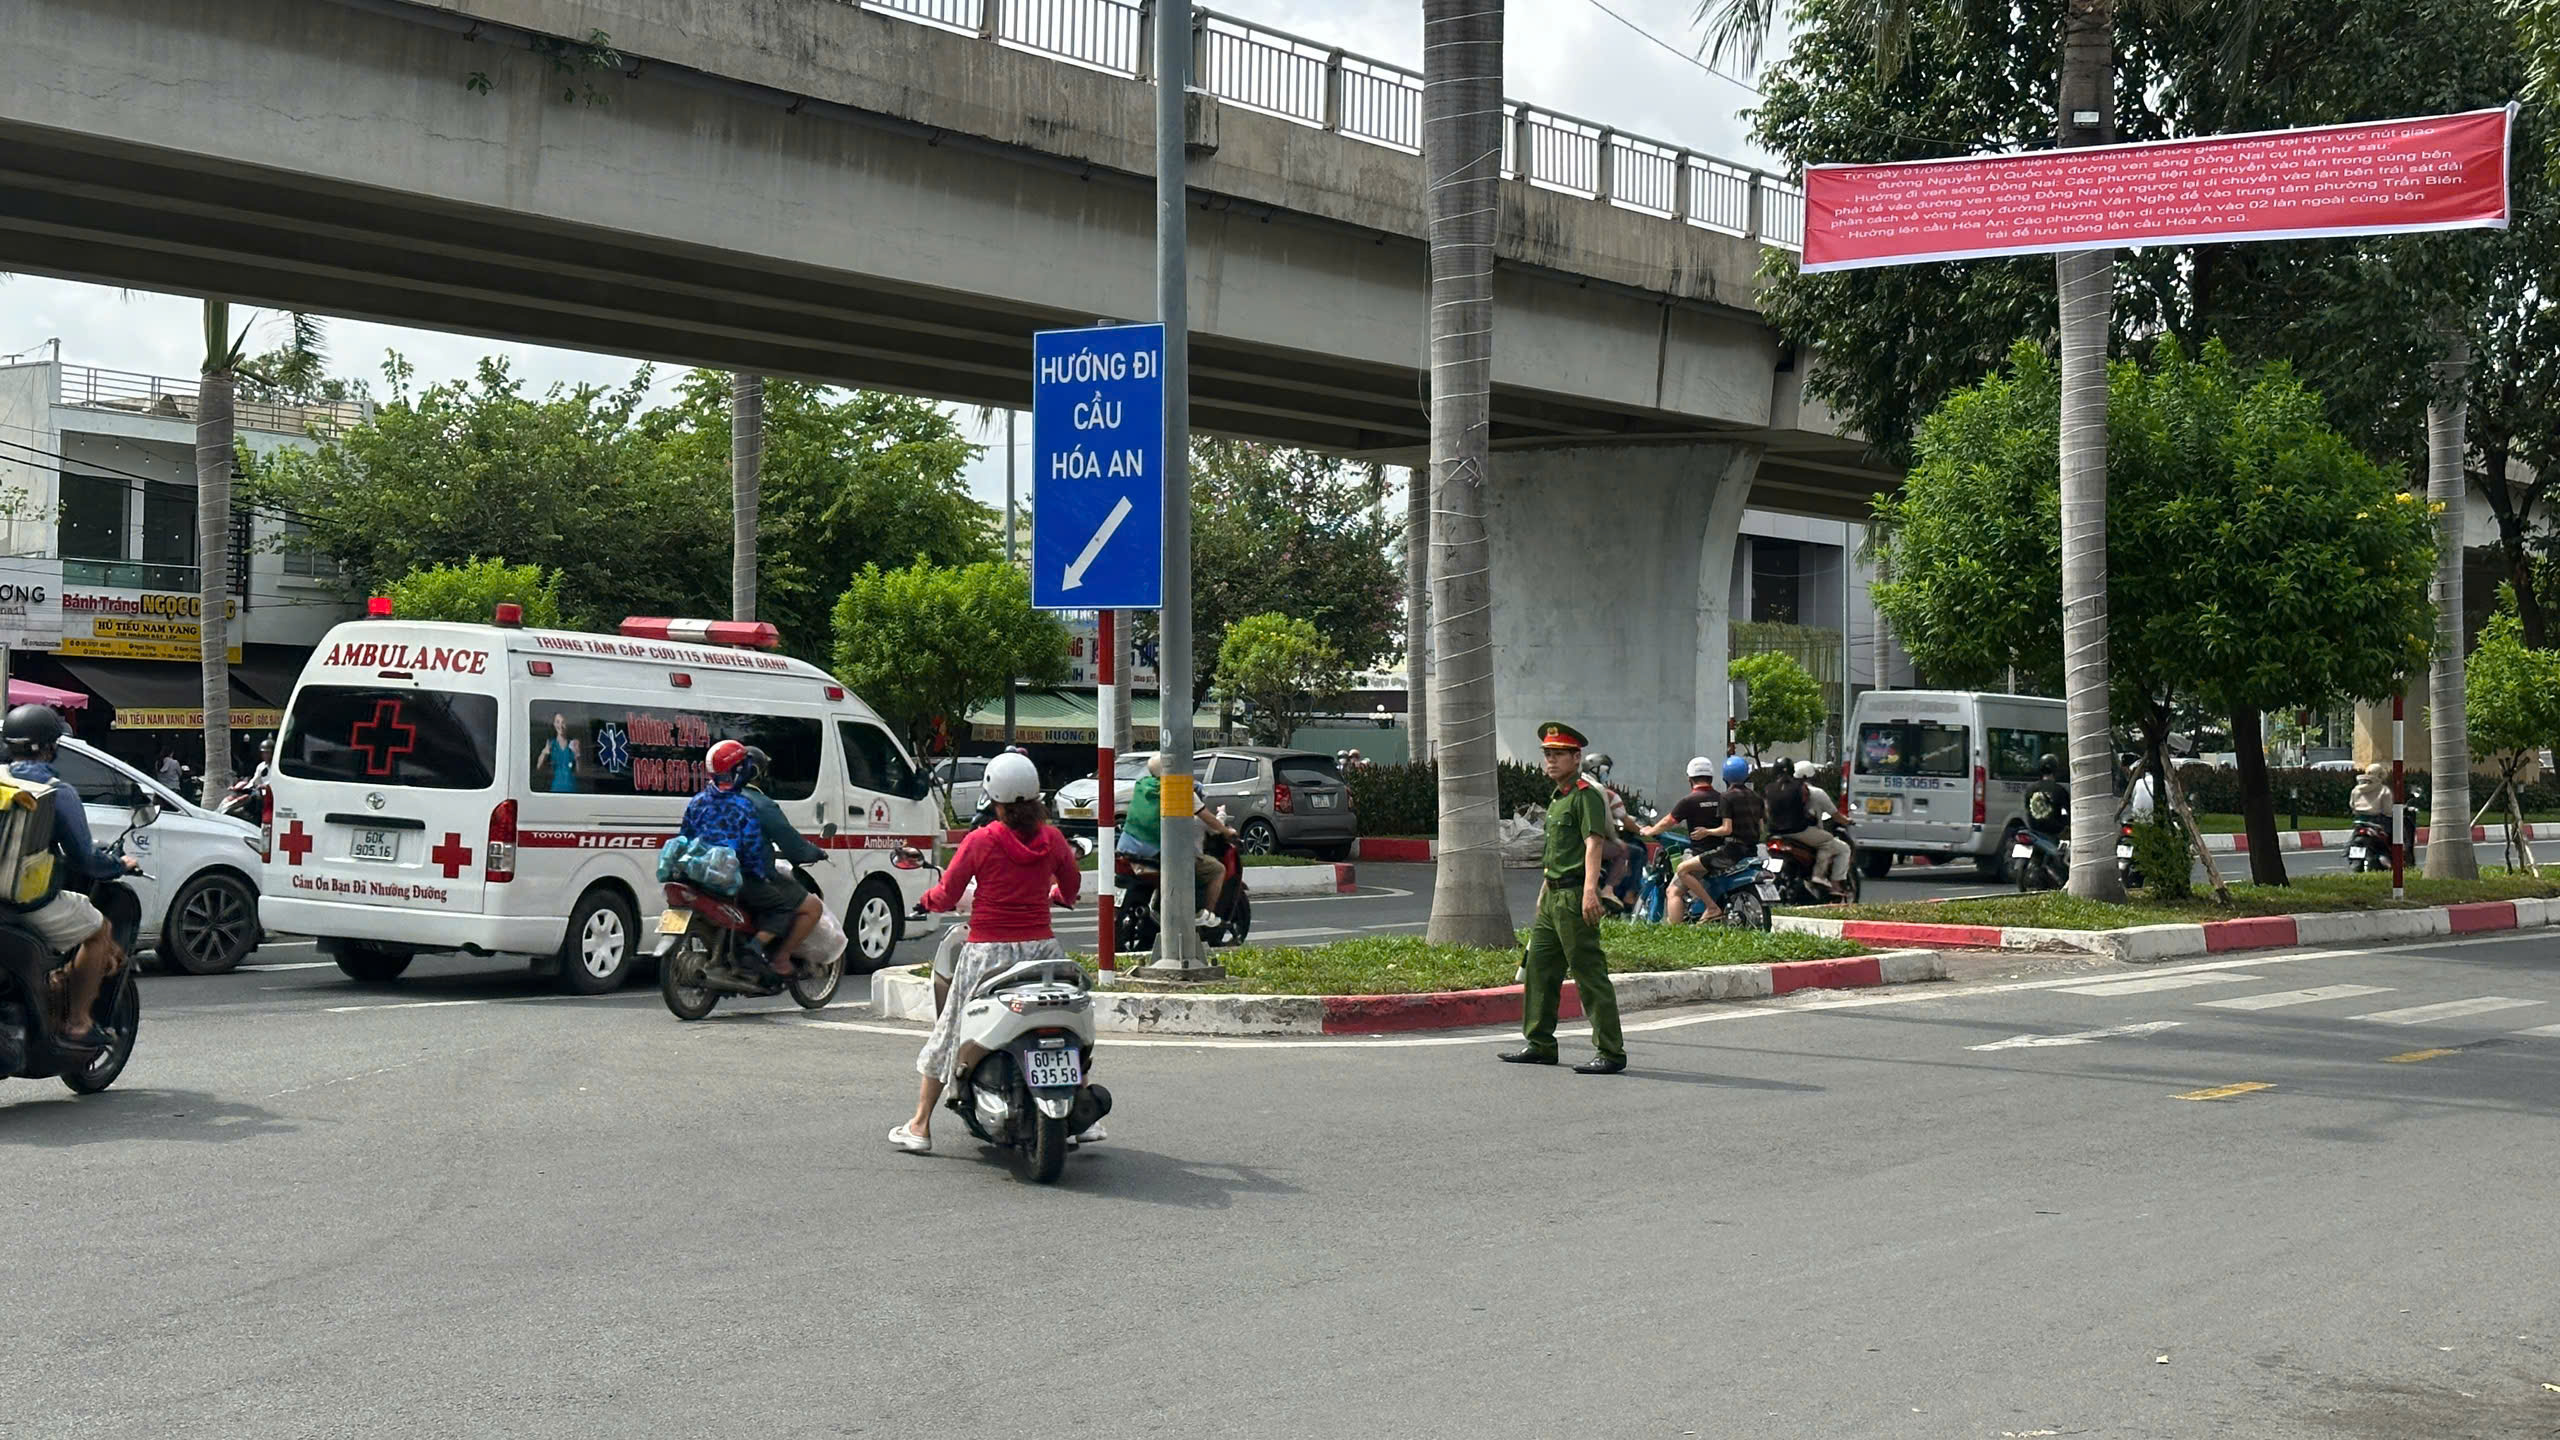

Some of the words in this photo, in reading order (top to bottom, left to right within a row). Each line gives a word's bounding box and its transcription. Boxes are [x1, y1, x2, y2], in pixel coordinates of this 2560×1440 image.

[2400, 128, 2435, 138] giao
[2249, 199, 2269, 209] 02
[1041, 347, 1126, 384] HƯỚNG
[1133, 350, 1157, 379] ĐI
[1073, 390, 1122, 430] CẦU
[1052, 444, 1100, 480] HÓA
[1108, 449, 1143, 477] AN
[143, 623, 166, 633] NAM
[169, 625, 198, 636] VANG
[323, 643, 489, 675] AMBULANCE
[534, 636, 584, 652] TRUNG
[584, 639, 617, 655] TÂM
[676, 650, 701, 663] 115
[755, 657, 789, 670] OANH
[147, 713, 165, 725] NAM
[166, 714, 186, 725] VANG
[633, 757, 665, 792] 0846
[666, 758, 690, 793] 879
[364, 831, 385, 844] 60K
[532, 831, 577, 839] TOYOTA
[578, 836, 658, 848] HIACE
[355, 844, 392, 858] 905.16
[292, 874, 314, 890] Cảm
[331, 878, 351, 896] Bạn
[352, 879, 367, 895] Đã
[1034, 1050, 1071, 1069] 60-F1
[1031, 1068, 1079, 1086] 635.58
